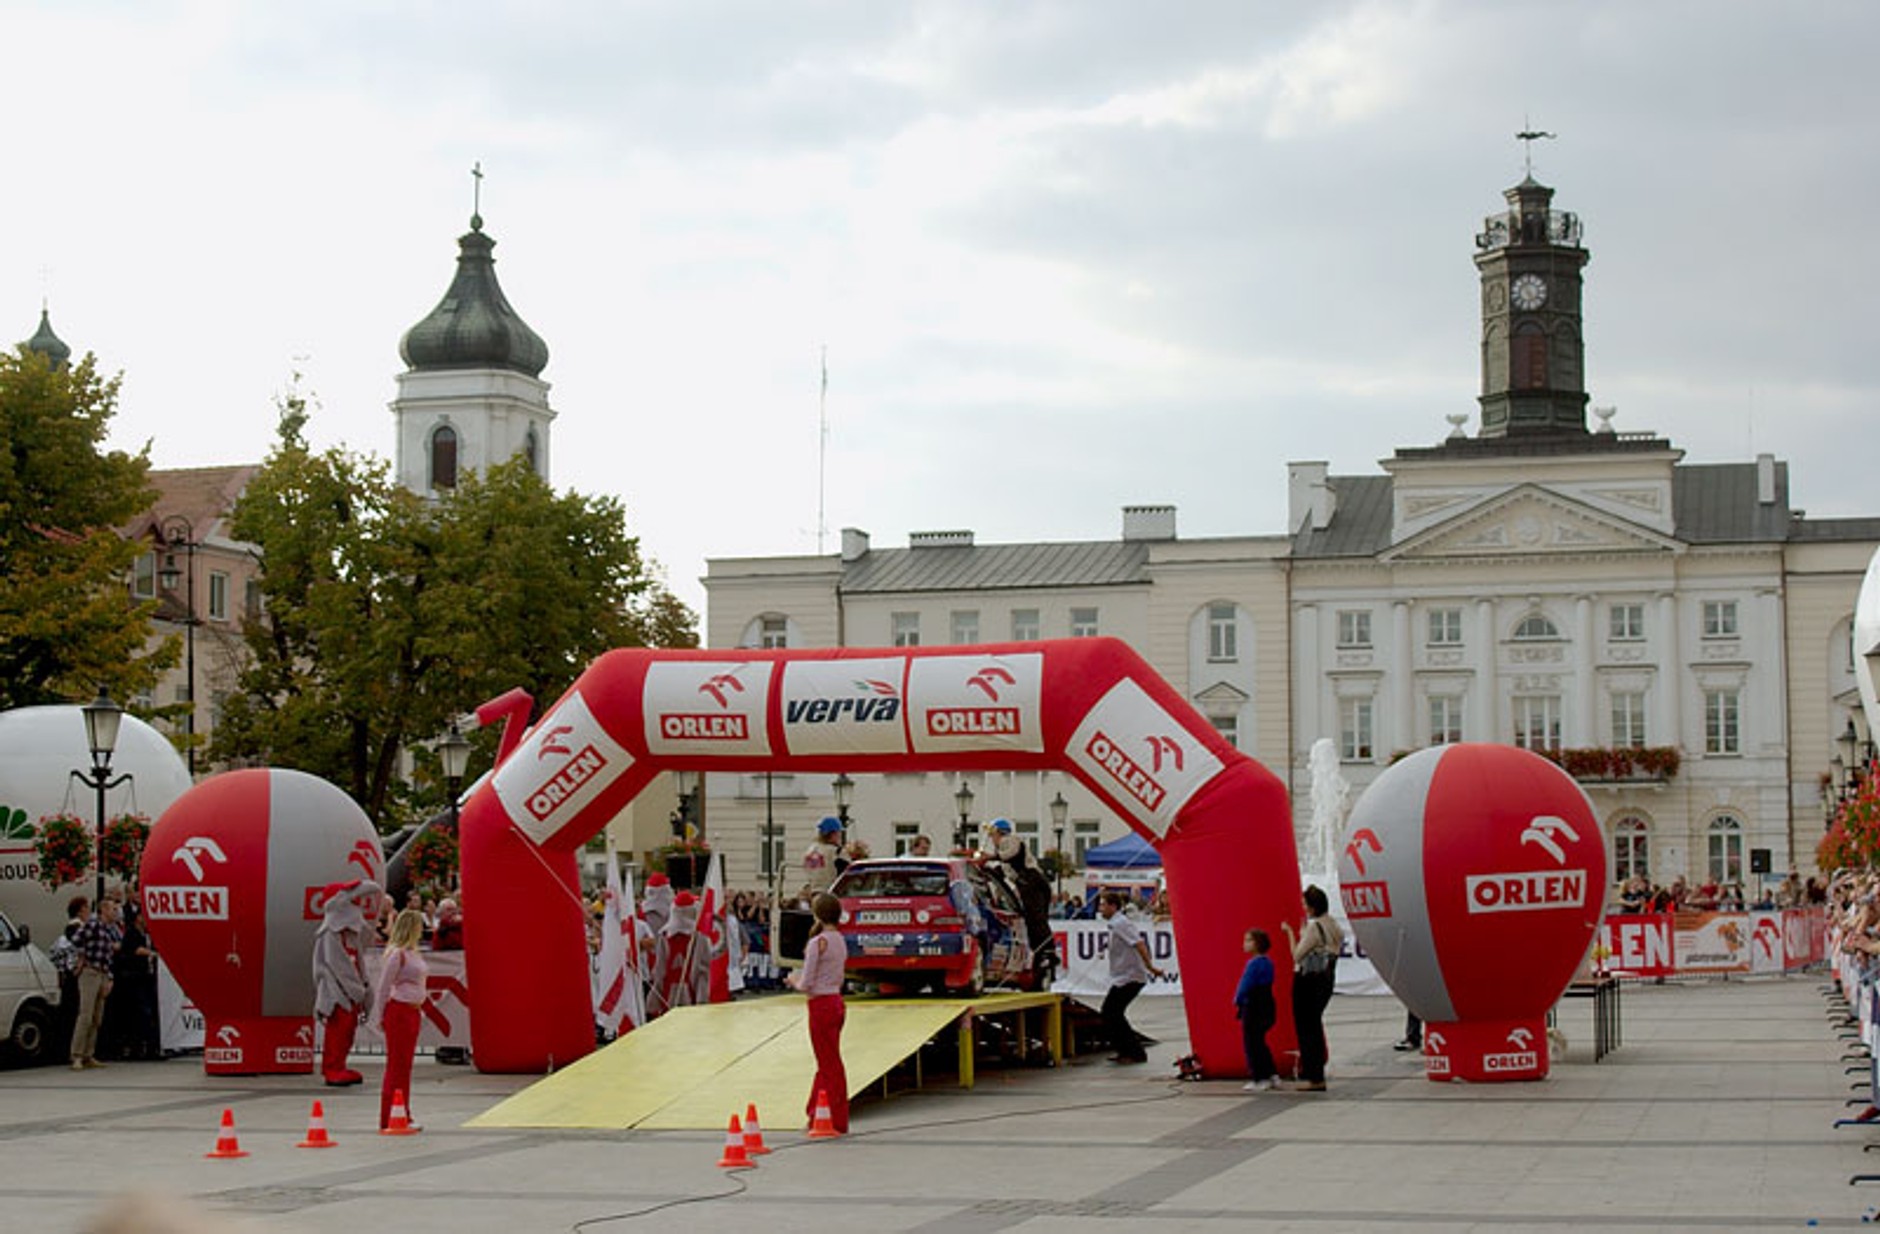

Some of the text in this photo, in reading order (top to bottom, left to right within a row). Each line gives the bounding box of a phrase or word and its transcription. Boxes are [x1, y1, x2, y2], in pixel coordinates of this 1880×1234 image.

[786, 696, 900, 724] verva
[930, 711, 1016, 733] ORLEN
[664, 716, 744, 738] ORLEN
[531, 751, 602, 816] ORLEN
[1091, 738, 1160, 805] ORLEN
[0, 864, 39, 880] OUP
[149, 891, 221, 915] ORLEN
[1473, 876, 1581, 907] ORLEN
[1487, 1054, 1534, 1069] ORLEN
